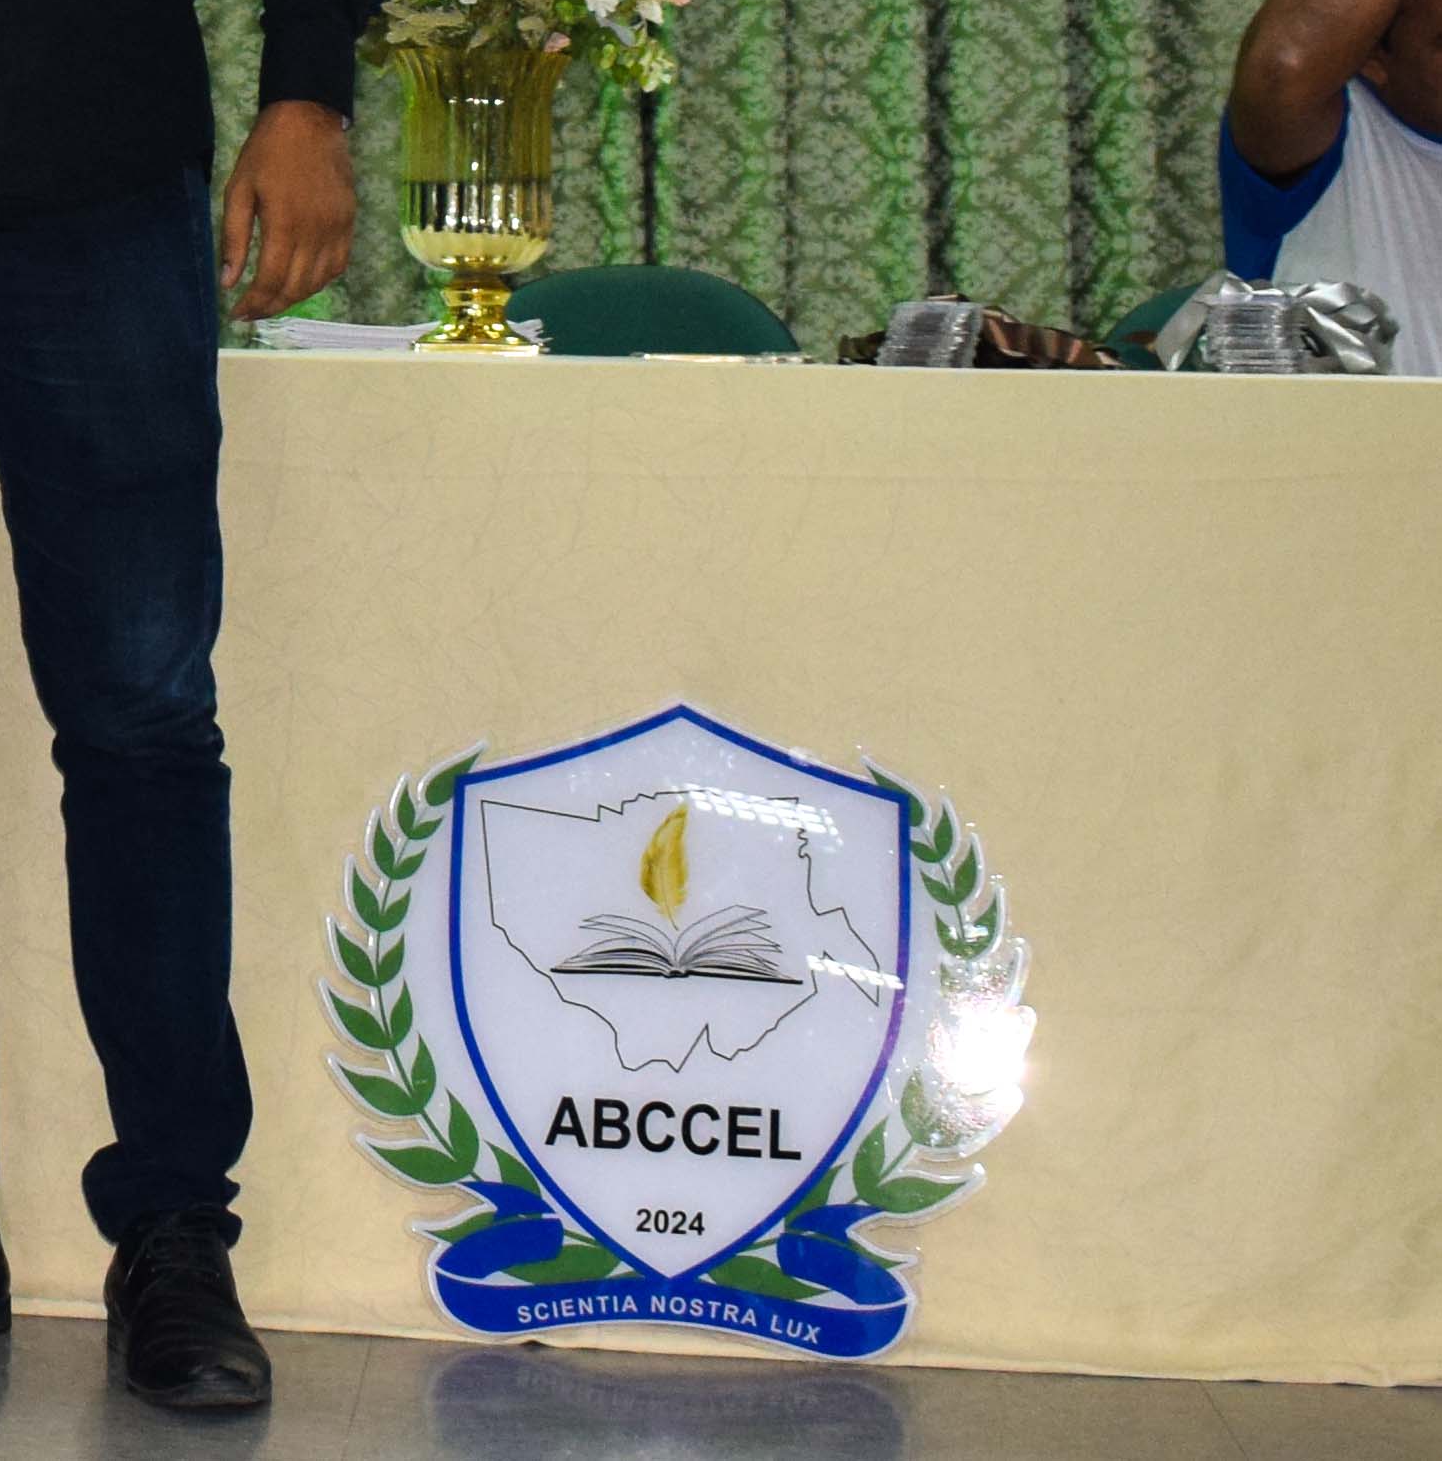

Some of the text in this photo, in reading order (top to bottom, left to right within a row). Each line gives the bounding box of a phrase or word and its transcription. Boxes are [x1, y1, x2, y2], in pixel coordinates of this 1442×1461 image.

[544, 1096, 802, 1160] ABCCEL
[635, 1208, 706, 1236] 2024
[517, 1295, 822, 1345] SCIENTIA NOSTRA LUX
